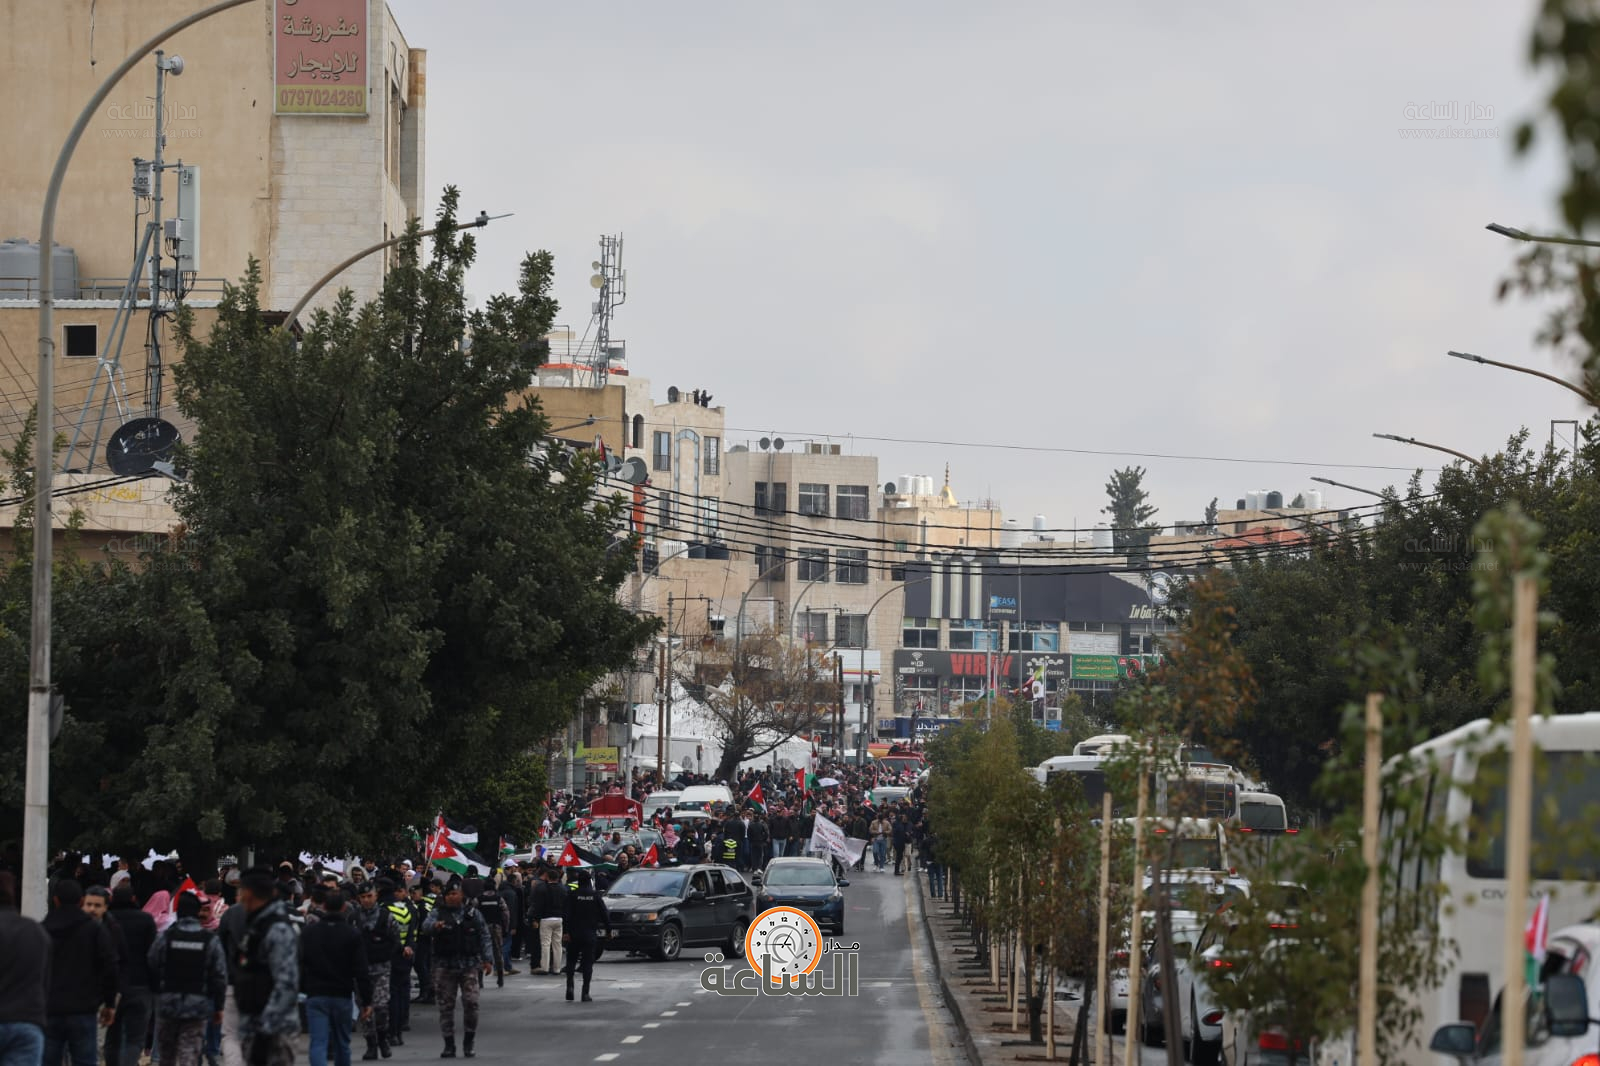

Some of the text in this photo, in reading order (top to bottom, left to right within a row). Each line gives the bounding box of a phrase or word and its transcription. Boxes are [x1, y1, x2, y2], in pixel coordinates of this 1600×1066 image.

[283, 16, 359, 42] مفروشة
[286, 49, 358, 81] للإيجار
[280, 89, 362, 106] 0797024260
